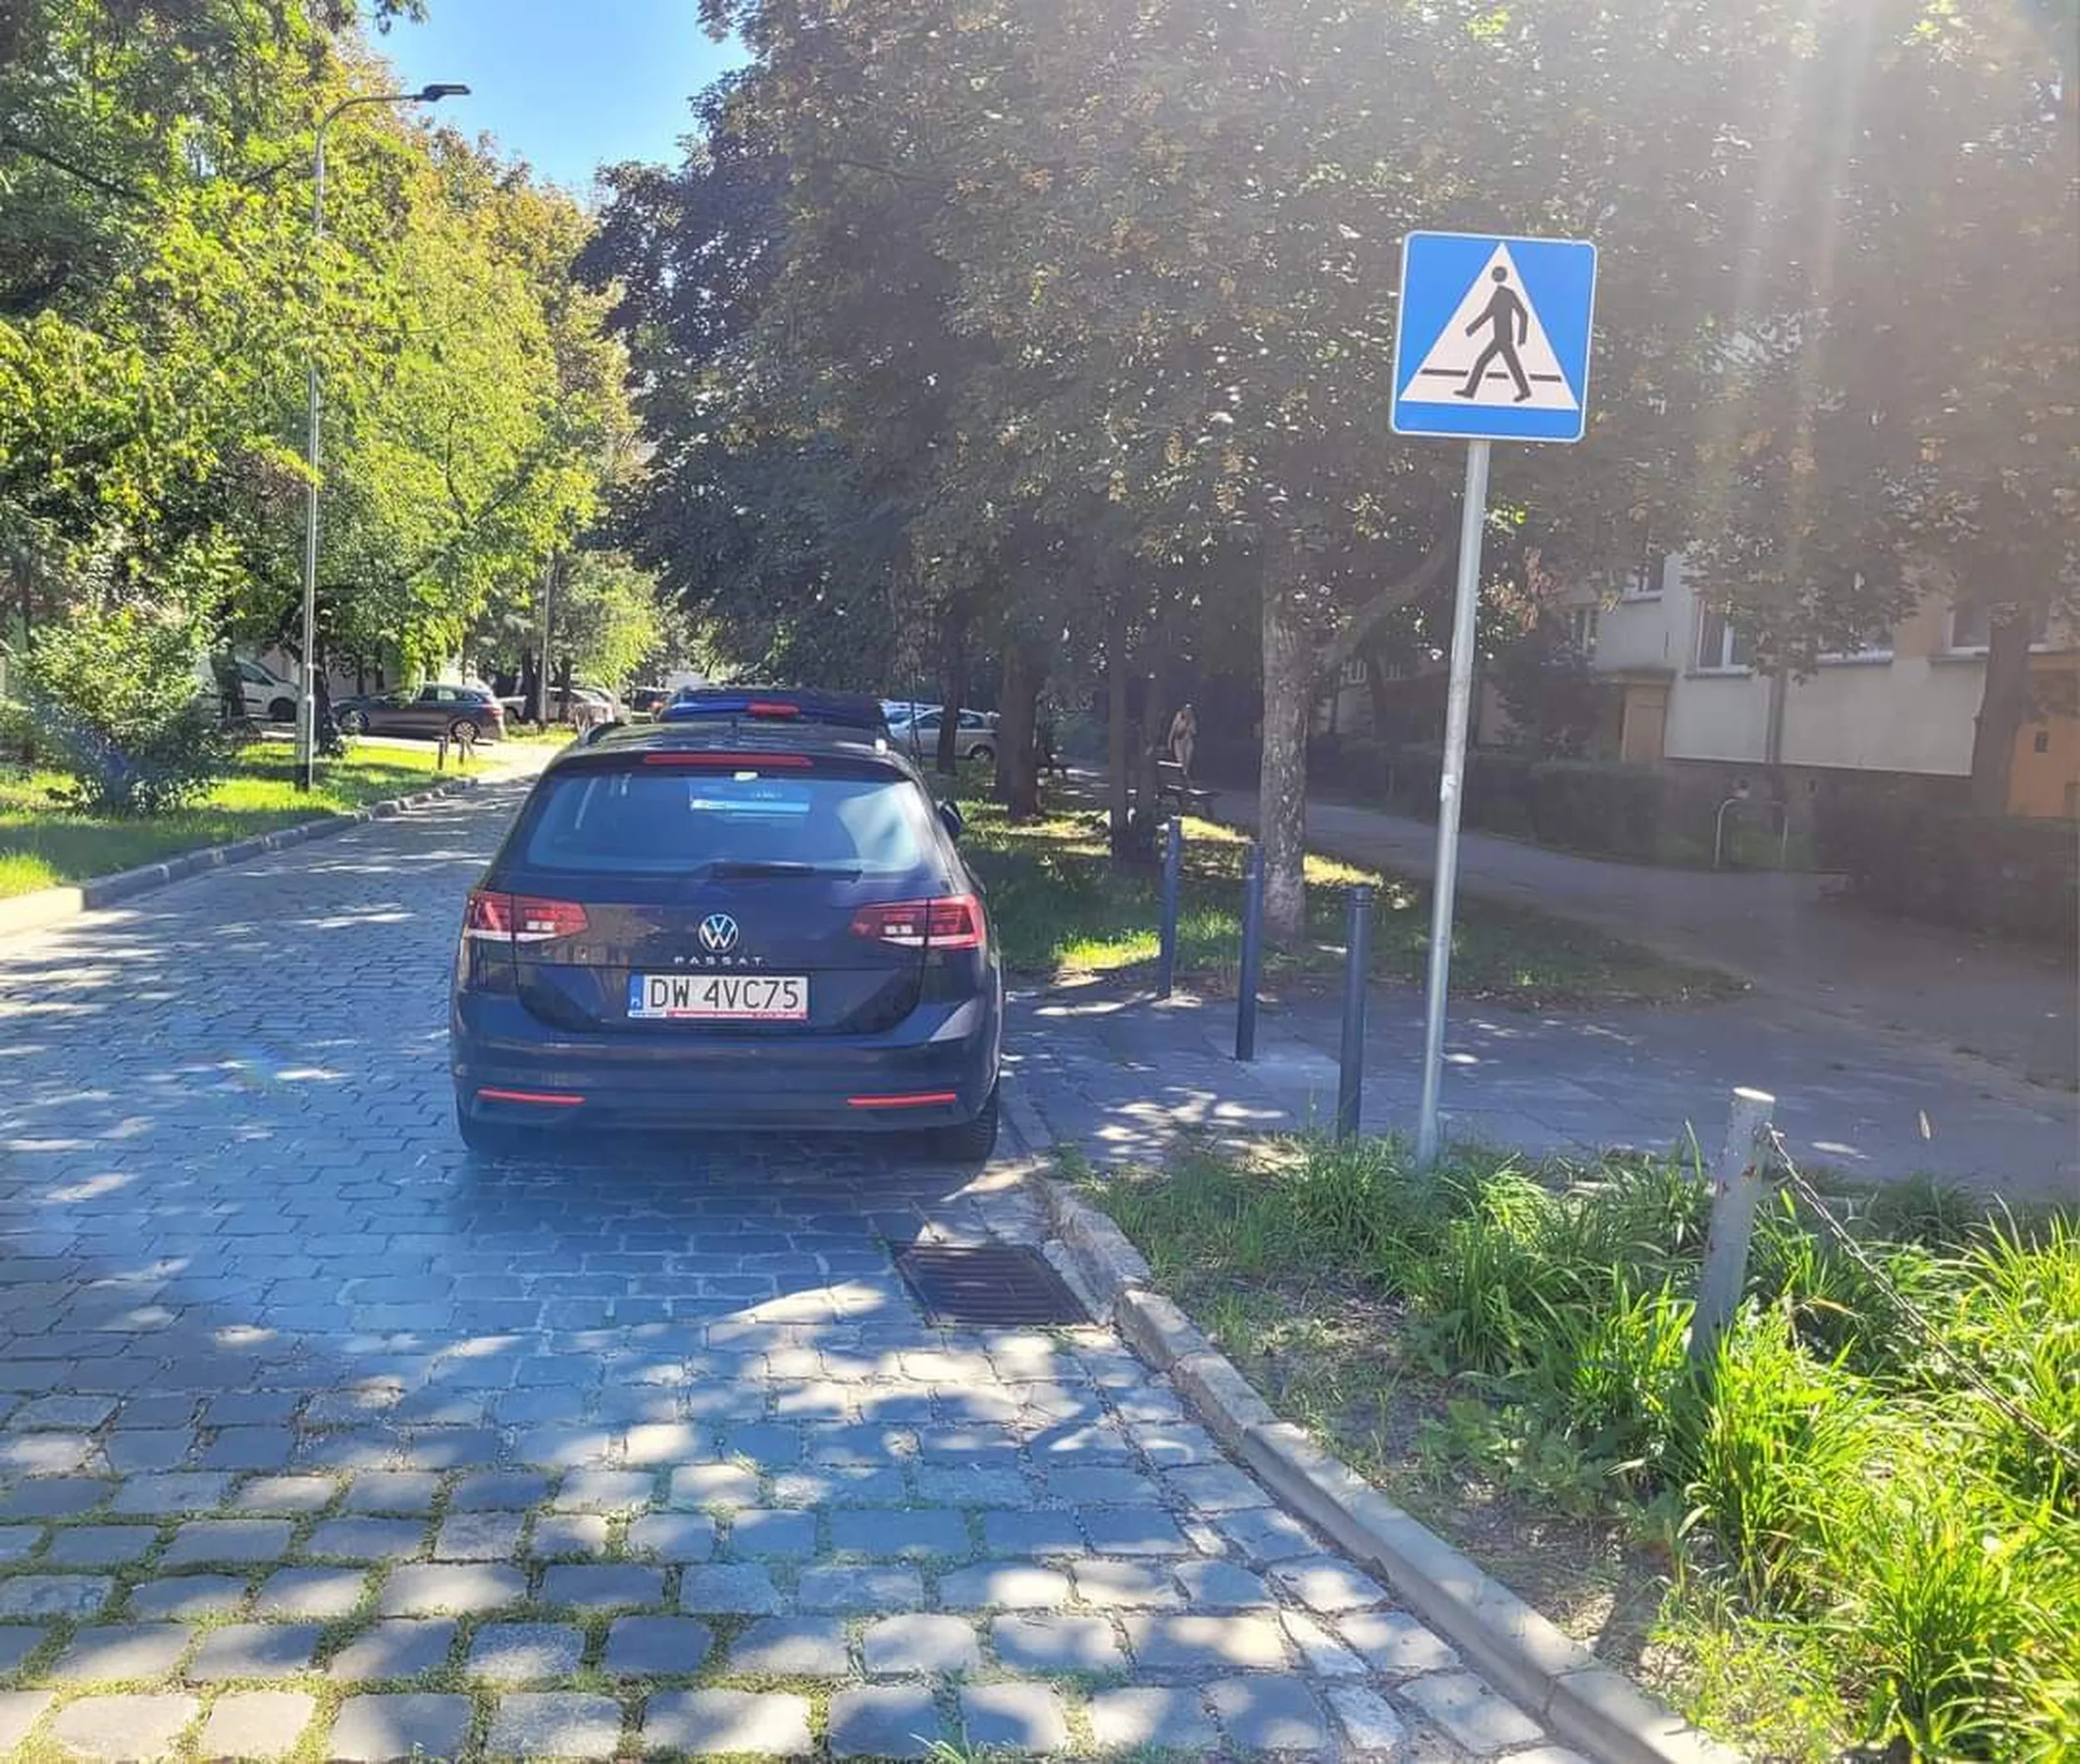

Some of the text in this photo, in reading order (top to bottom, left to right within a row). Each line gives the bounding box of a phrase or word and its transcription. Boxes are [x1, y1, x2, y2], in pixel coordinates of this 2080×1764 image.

[701, 915, 737, 949] VW
[673, 956, 763, 966] PASSAT
[651, 978, 800, 1009] DW 4VC75
